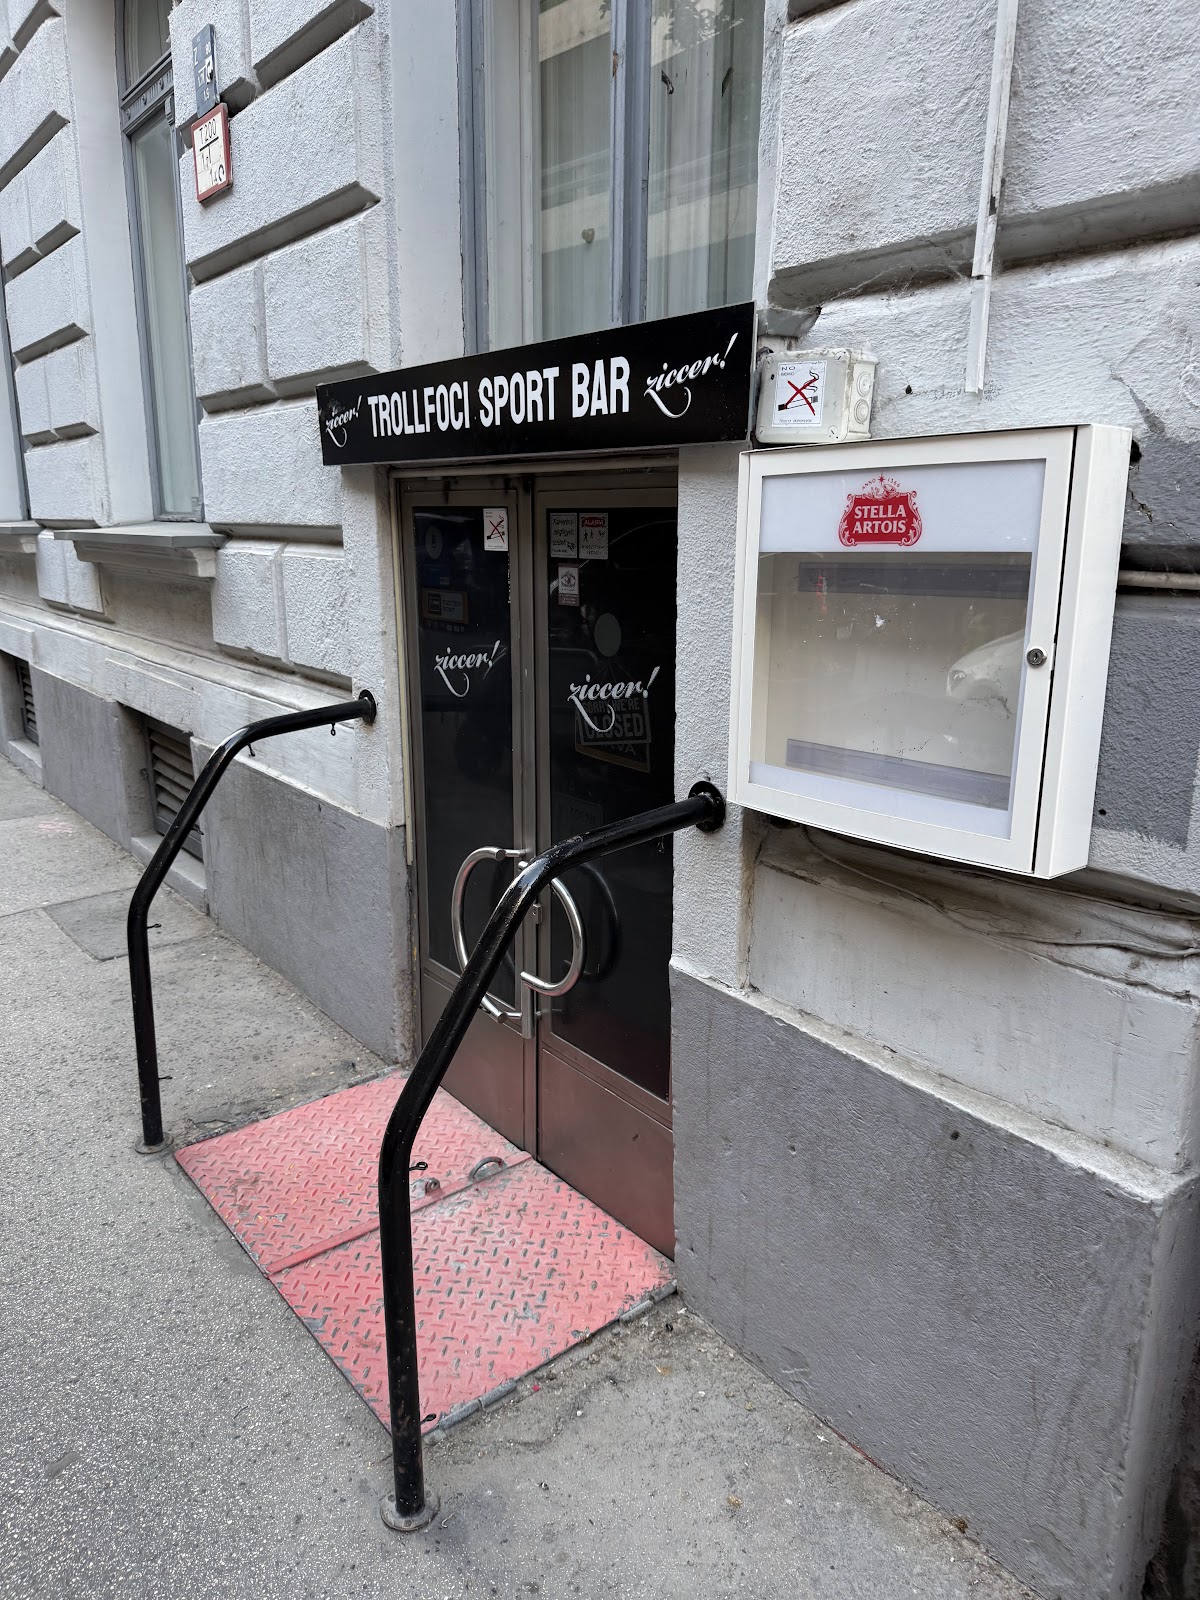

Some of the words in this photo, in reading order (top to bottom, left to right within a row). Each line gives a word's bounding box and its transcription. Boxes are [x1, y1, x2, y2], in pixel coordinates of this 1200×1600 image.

[367, 381, 470, 438] TROLLFOCI
[479, 366, 561, 429] SPORT
[571, 356, 631, 419] BAR
[643, 332, 739, 419] ziccer!
[861, 477, 877, 490] ANNO
[854, 504, 907, 519] STELLA
[852, 520, 907, 535] ARTOIS
[433, 640, 501, 697] ziccer!
[567, 666, 661, 732] ziccer!
[582, 699, 610, 714] SORRY
[583, 712, 645, 740] CLOSED
